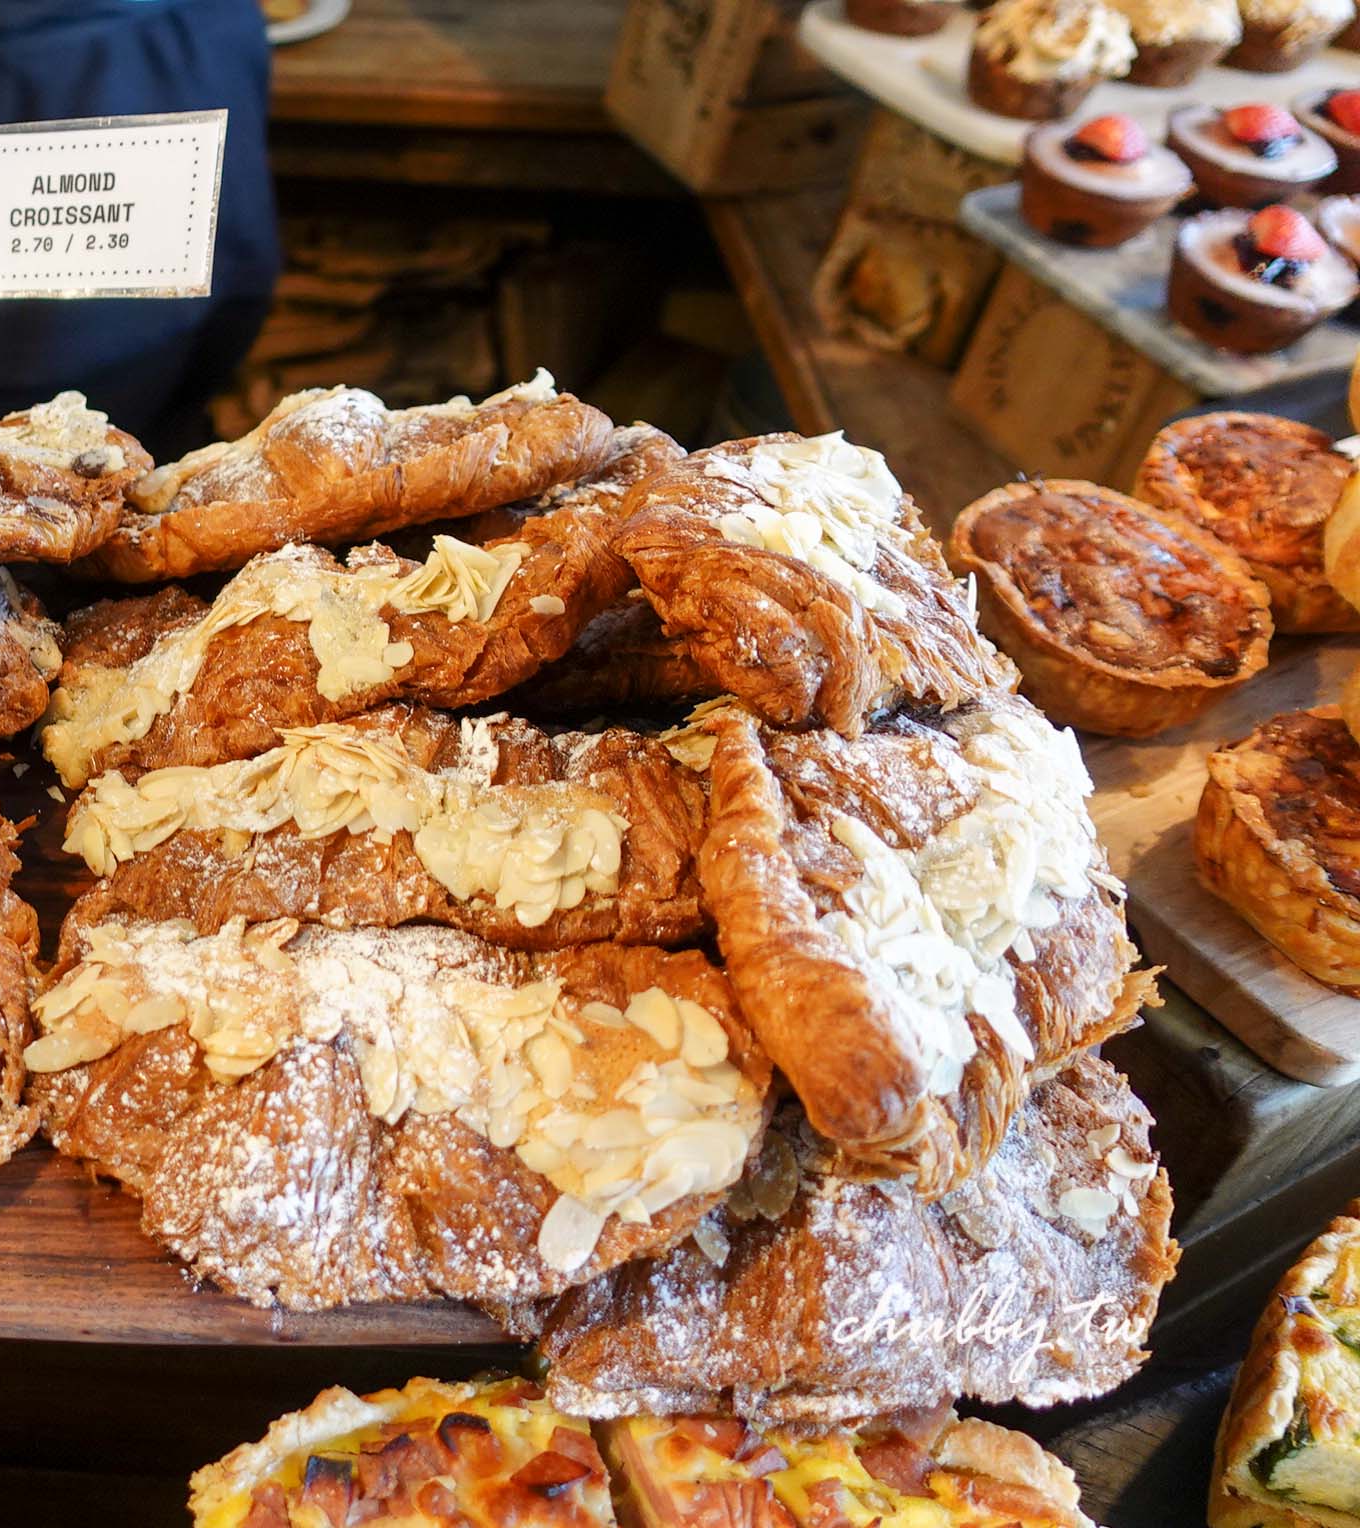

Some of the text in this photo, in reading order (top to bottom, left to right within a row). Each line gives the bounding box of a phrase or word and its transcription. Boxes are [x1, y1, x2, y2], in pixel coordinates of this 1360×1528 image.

[31, 172, 116, 195] ALMOND
[10, 203, 135, 228] CROISSANT
[11, 233, 129, 253] 2.70 / 2.30
